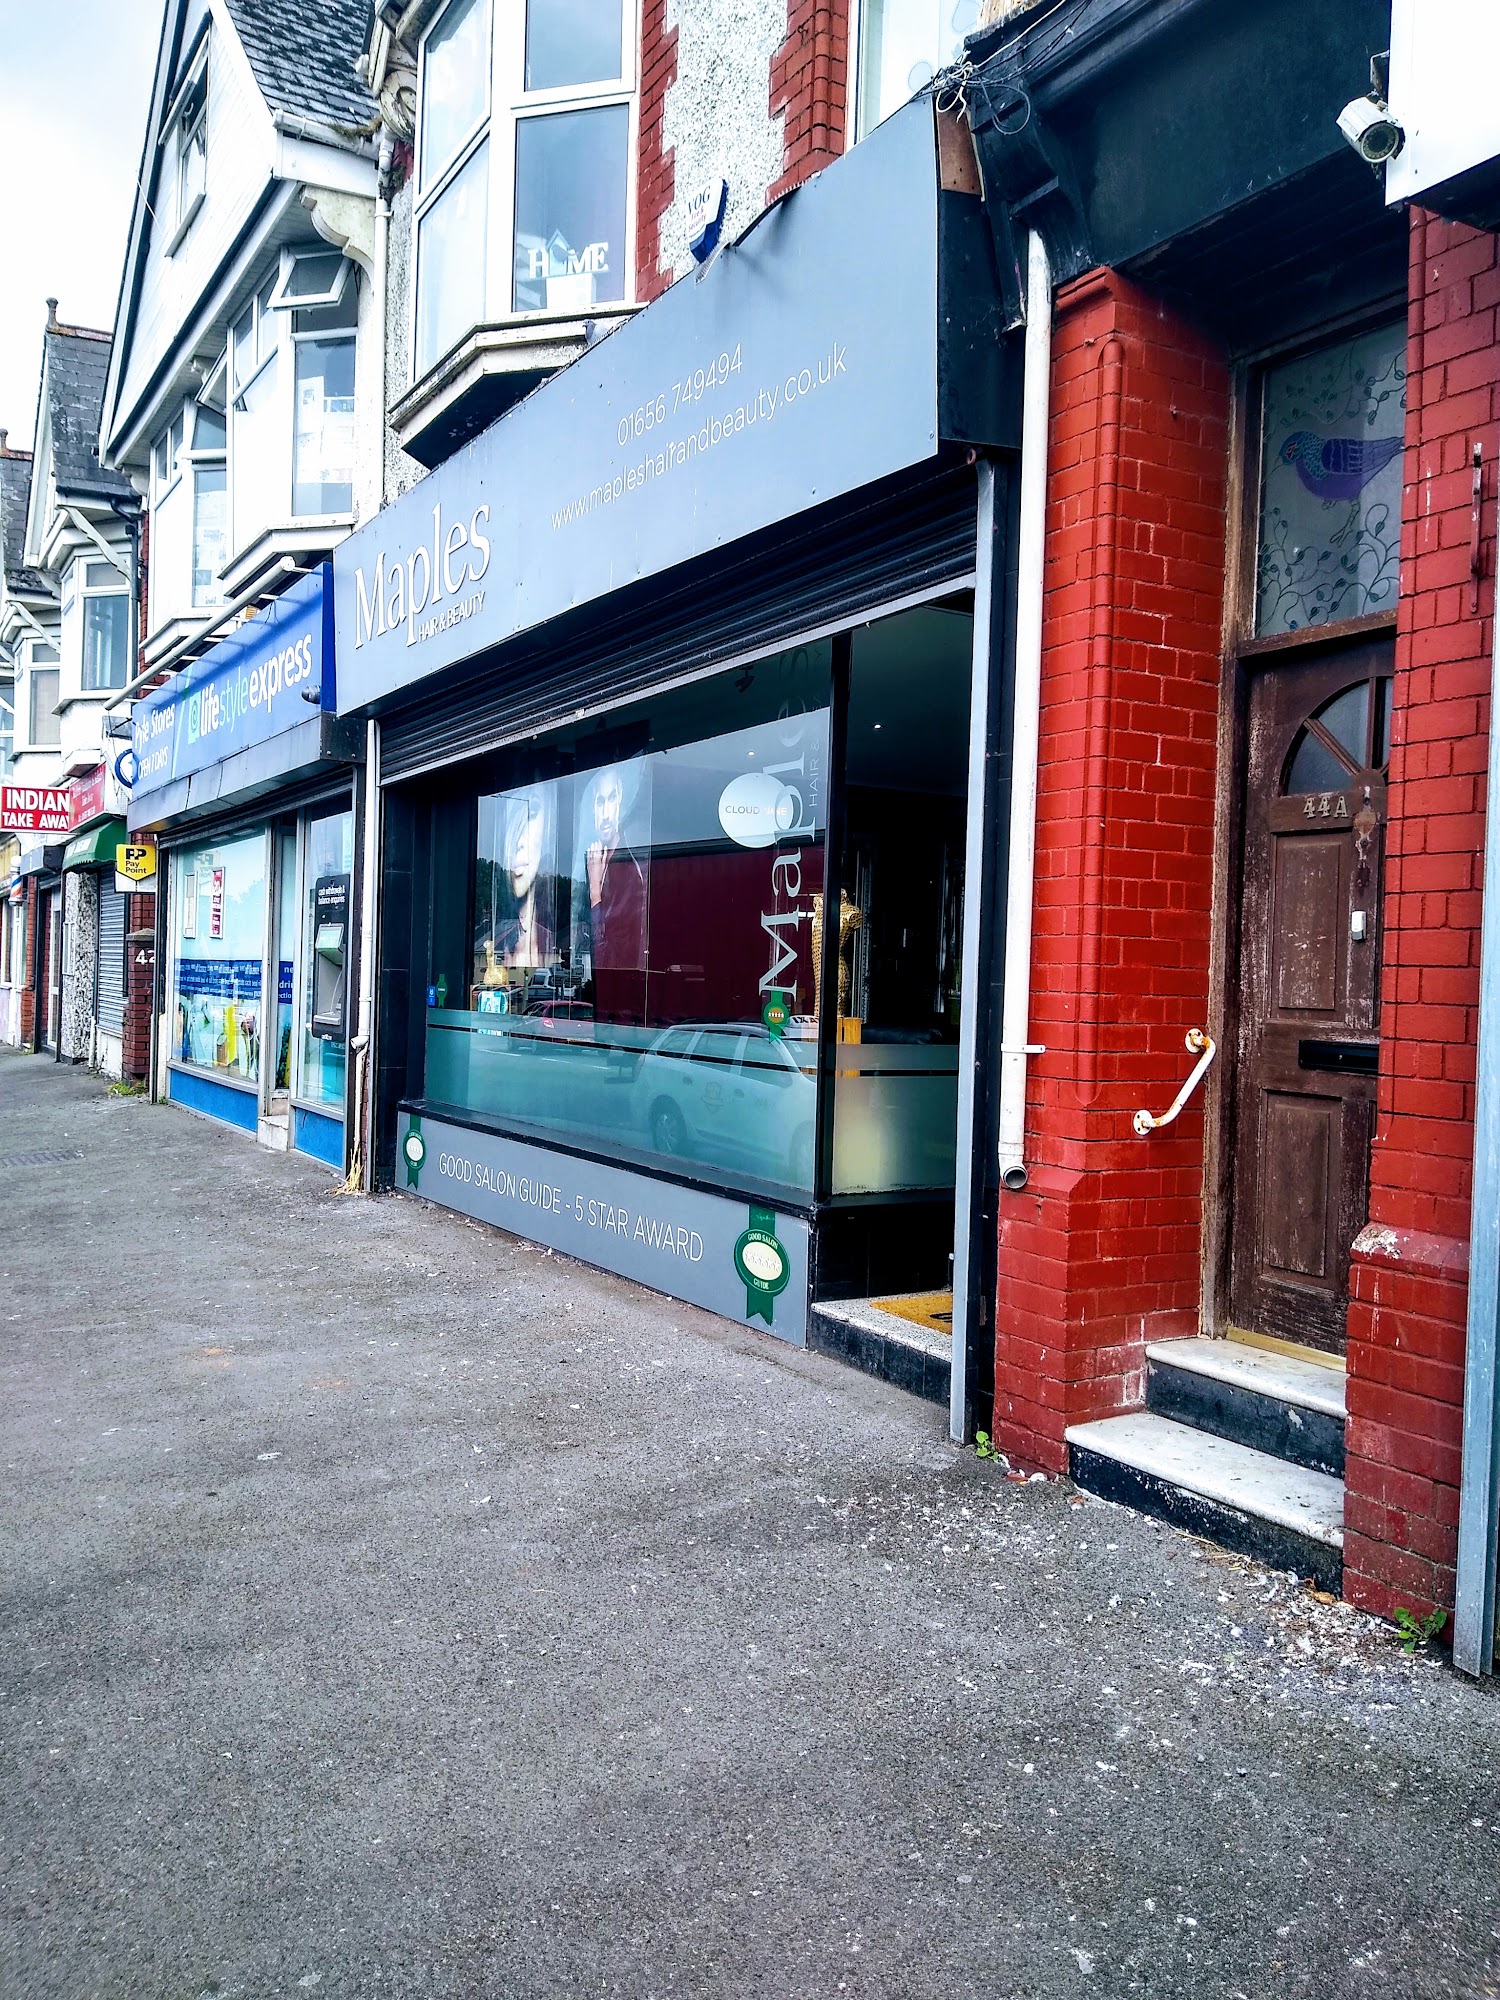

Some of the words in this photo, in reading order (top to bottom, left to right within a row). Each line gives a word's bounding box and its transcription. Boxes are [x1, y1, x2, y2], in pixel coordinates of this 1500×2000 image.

[617, 393, 666, 447] 01656
[671, 342, 743, 414] 749494
[550, 341, 848, 531] www.mapleshairandbeauty.co.uk
[354, 501, 491, 649] Maples
[418, 616, 438, 643] HAIR
[438, 612, 447, 632] &
[446, 591, 486, 629] BEAUTY
[150, 702, 176, 739] Stores
[810, 738, 820, 751] &
[137, 753, 150, 780] OPEN
[152, 745, 169, 773] DAYS
[808, 758, 820, 807] HAIR
[6, 788, 69, 812] INDIAN
[725, 805, 760, 815] CLOUD
[1302, 795, 1349, 819] 44A
[2, 813, 34, 827] TAKE
[758, 645, 816, 1002] Maples
[125, 860, 140, 869] Pay
[125, 866, 147, 874] Point
[439, 1152, 472, 1183] GOOD
[474, 1163, 516, 1199] SALON
[518, 1176, 562, 1214] GUIDE
[574, 1195, 584, 1222] 5
[587, 1201, 628, 1238] STAR
[632, 1215, 704, 1262] AWARD
[747, 1233, 762, 1241] GOOD
[761, 1234, 779, 1250] SALON
[753, 1278, 770, 1290] GUIDE
